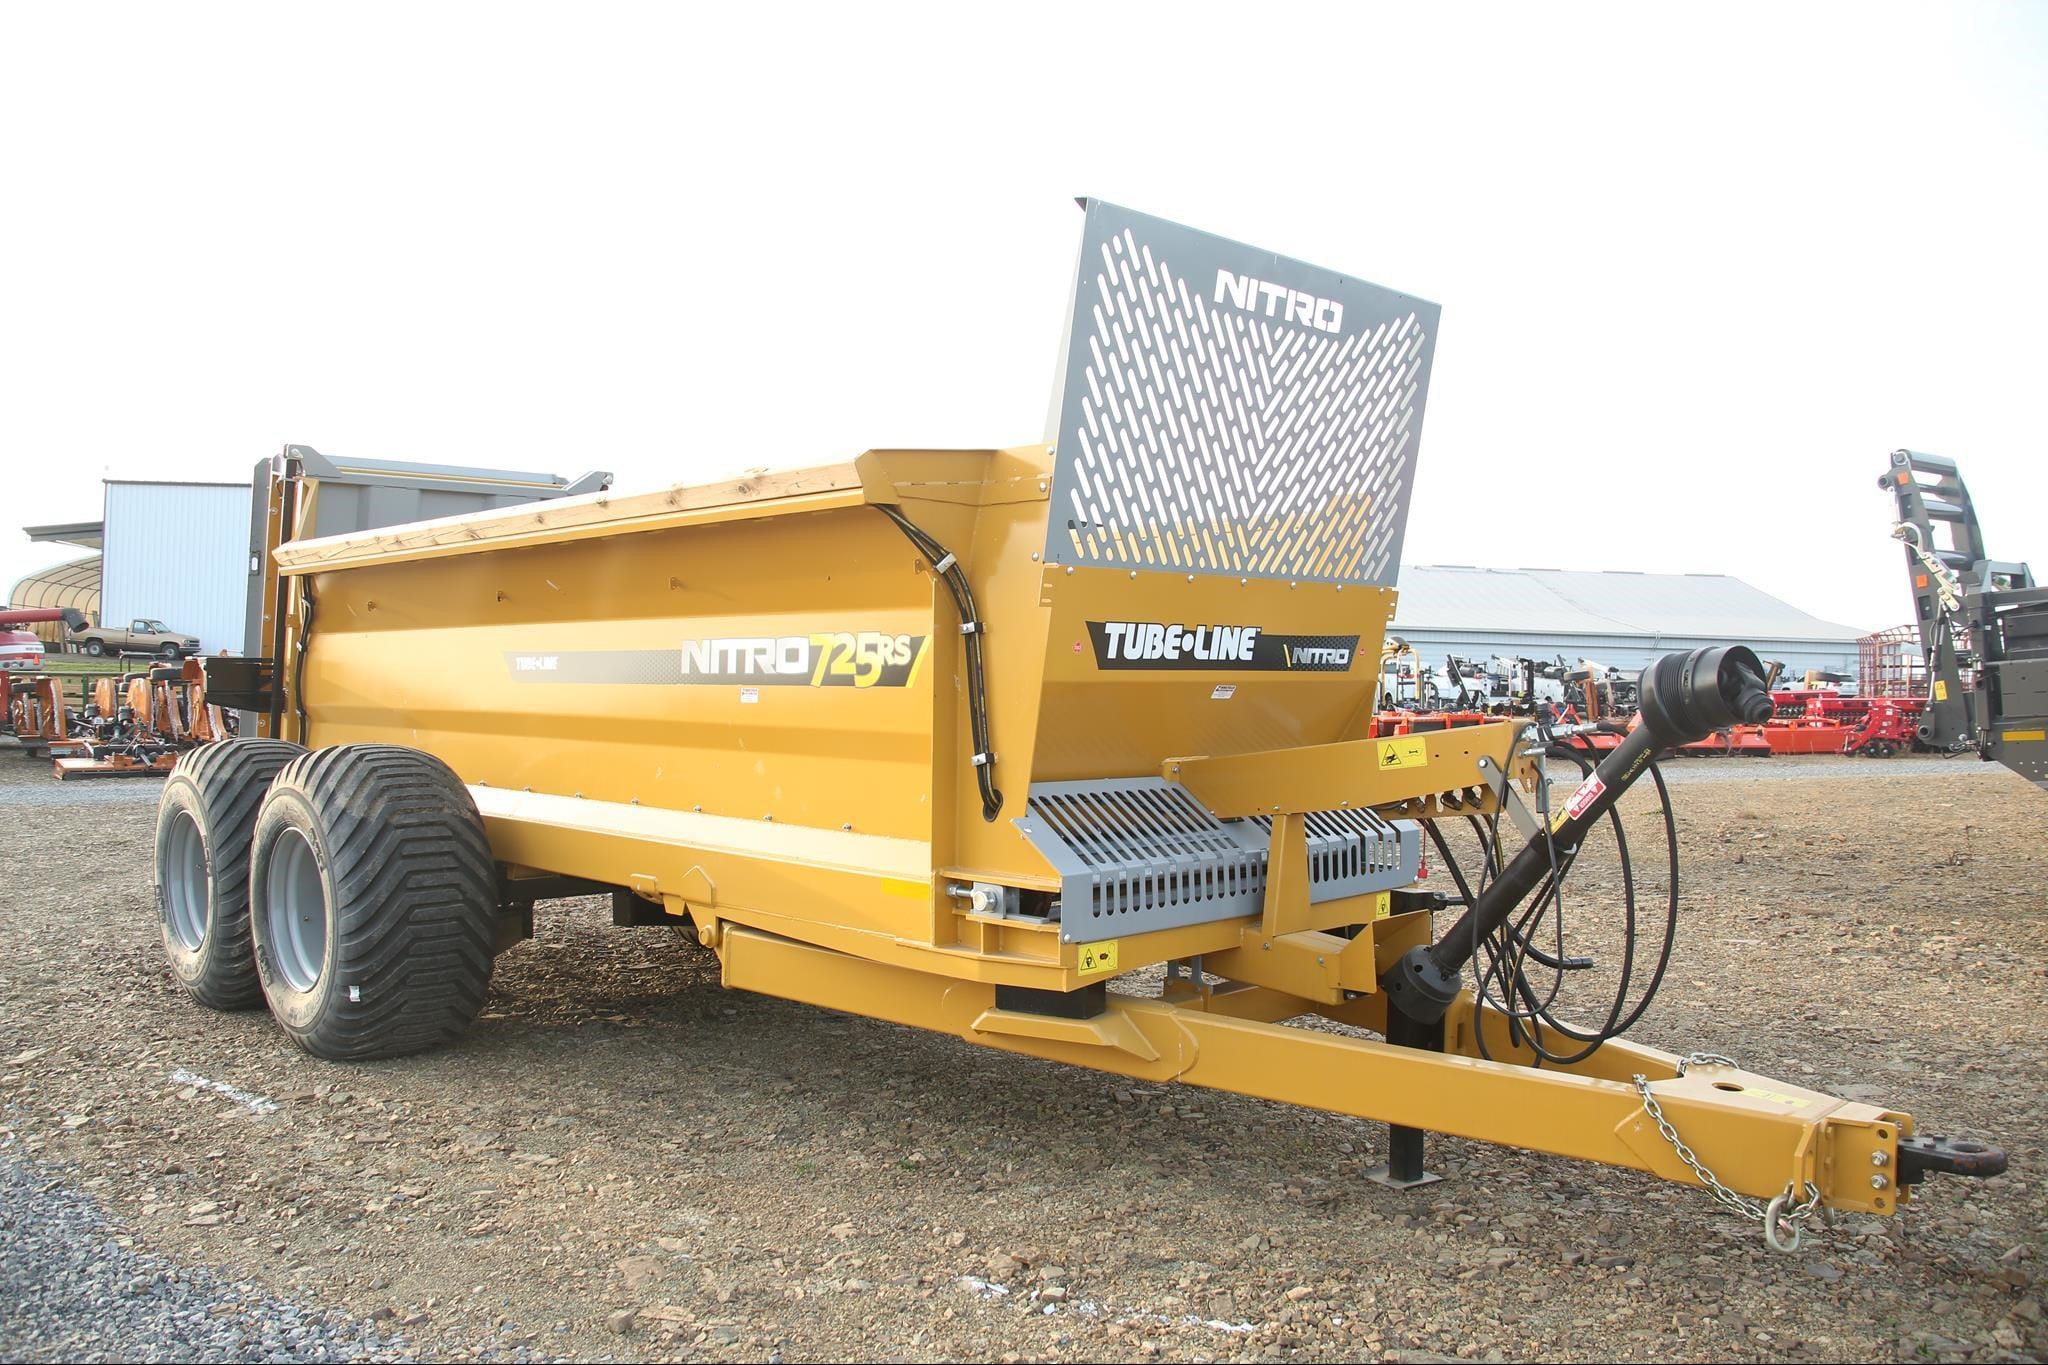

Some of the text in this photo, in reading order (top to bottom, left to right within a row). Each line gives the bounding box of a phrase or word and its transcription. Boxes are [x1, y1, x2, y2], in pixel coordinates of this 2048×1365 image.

[1214, 269, 1344, 334] NITRO
[680, 636, 809, 675] NITRO
[1291, 647, 1350, 665] NITRO
